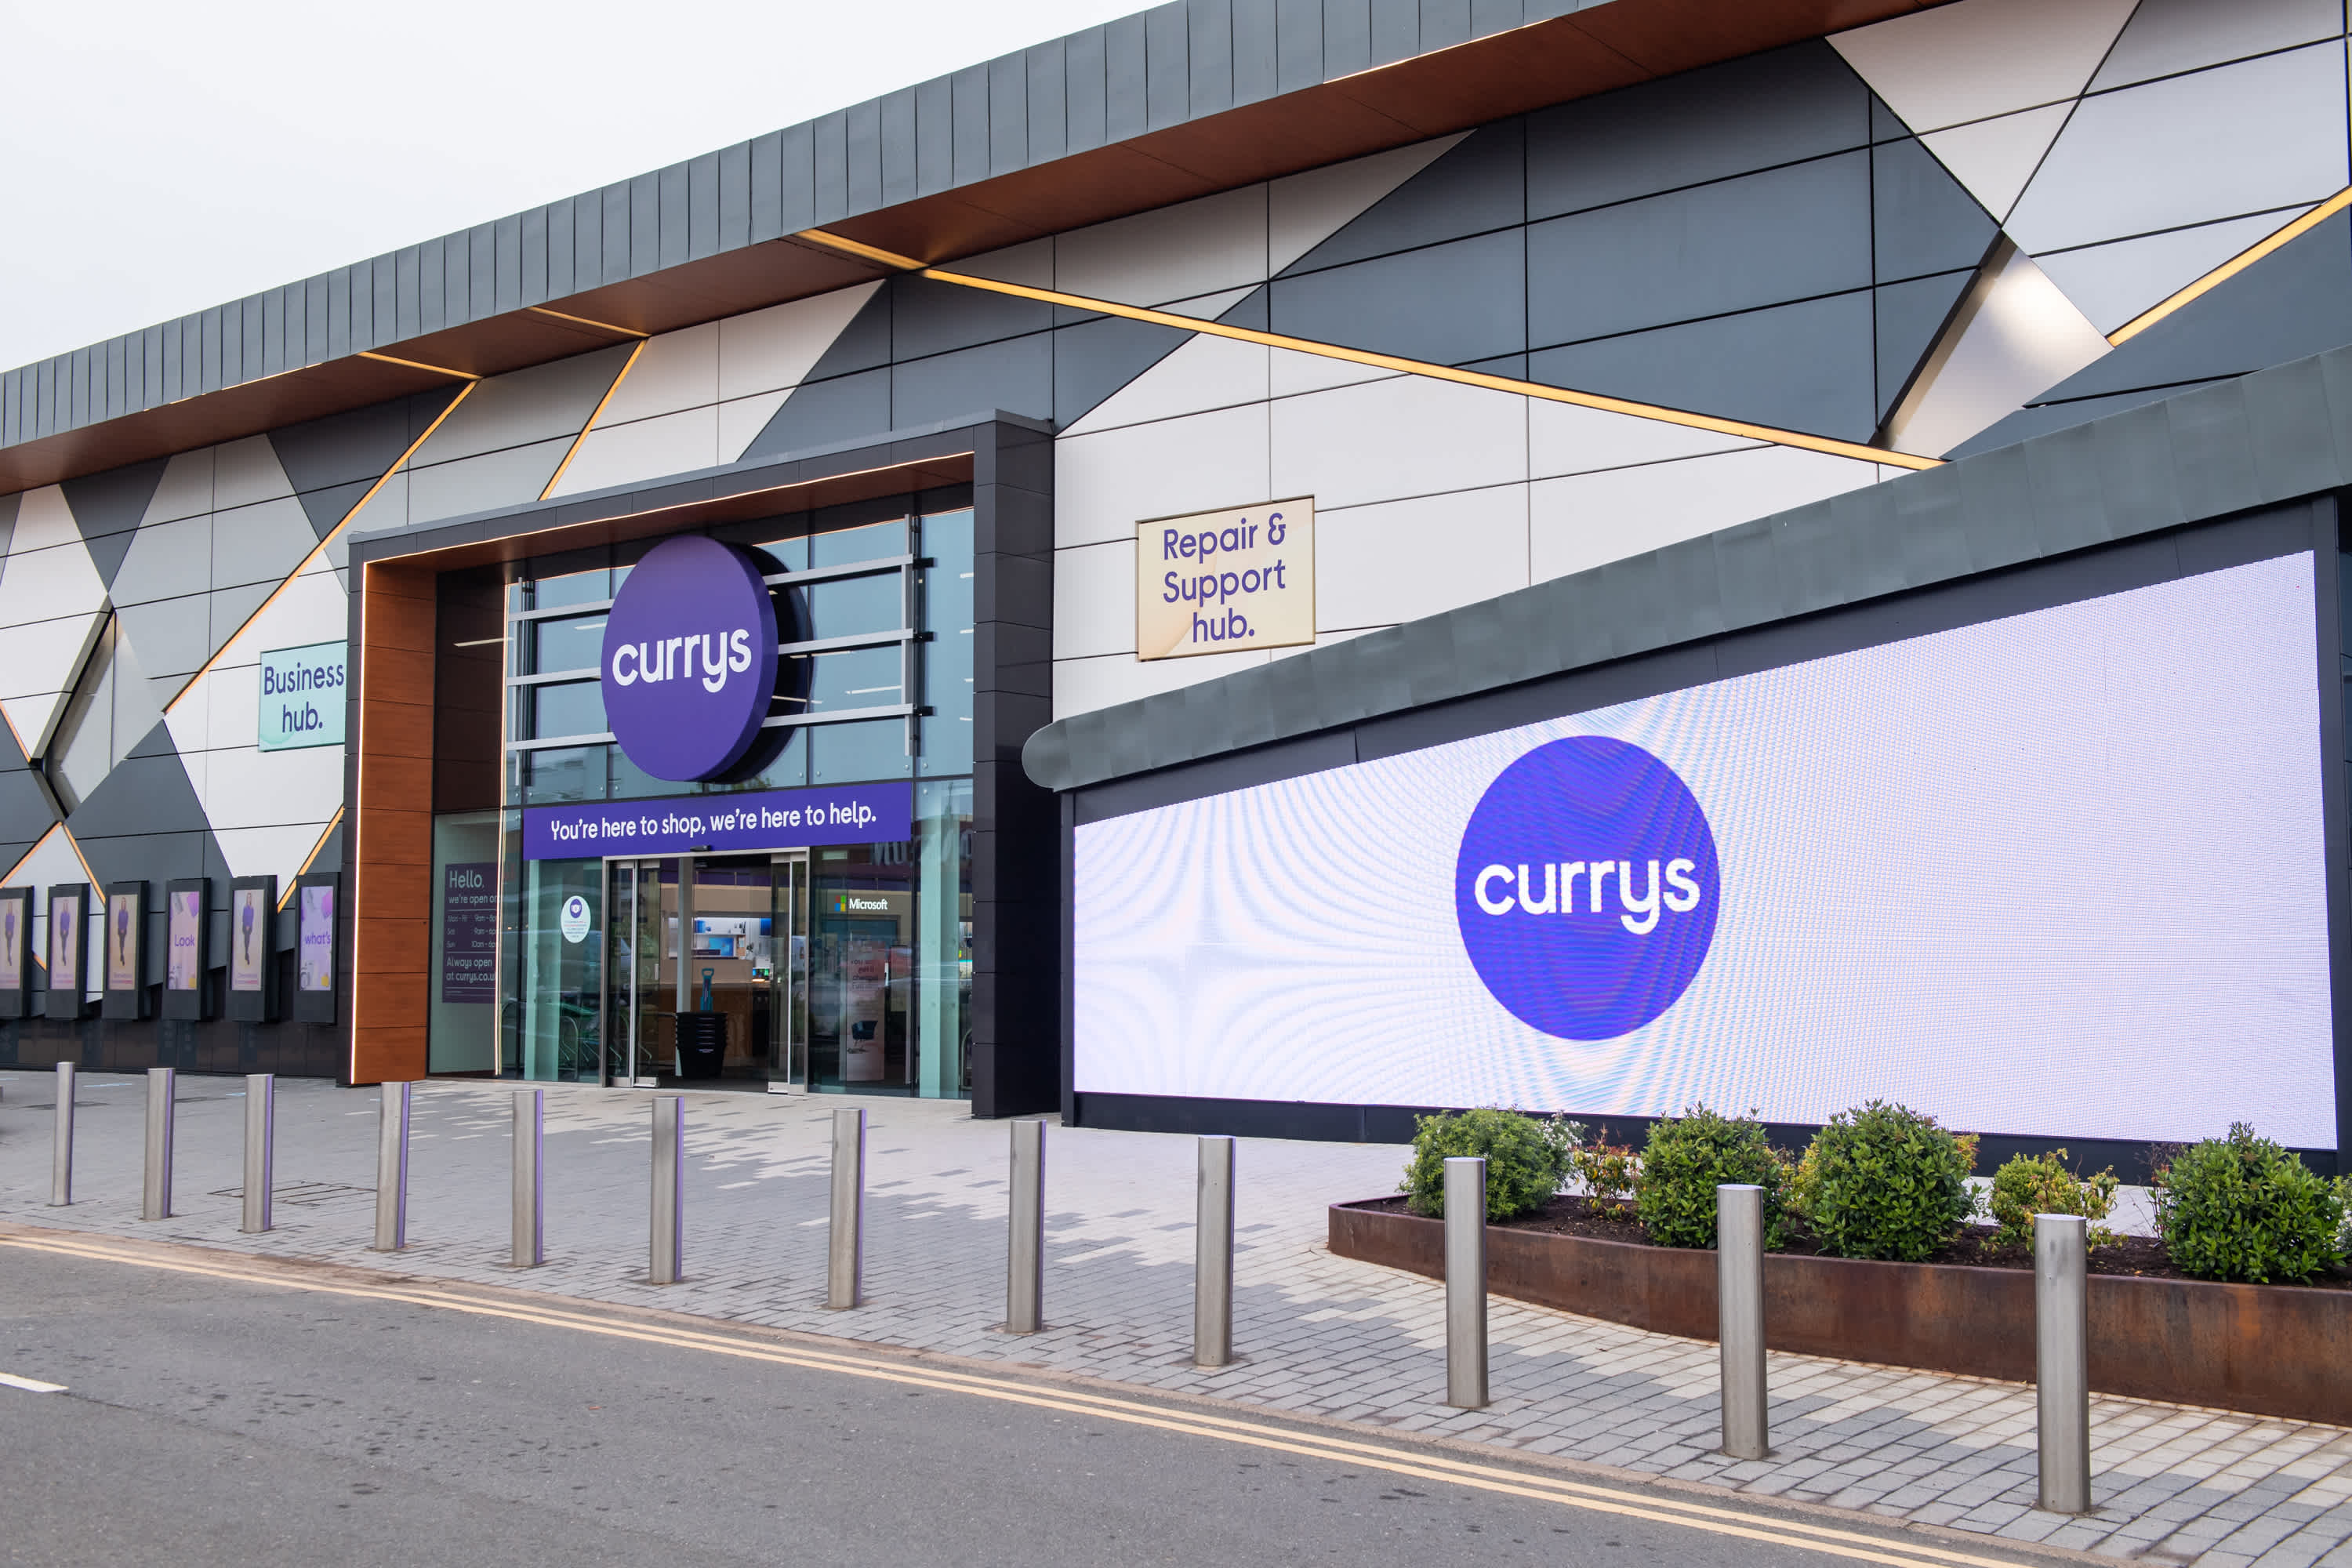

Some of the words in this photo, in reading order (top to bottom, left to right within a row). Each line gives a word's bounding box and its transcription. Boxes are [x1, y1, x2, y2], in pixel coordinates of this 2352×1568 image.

[1163, 517, 1258, 564] Repair
[1268, 513, 1286, 545] &
[1163, 559, 1286, 608] Support
[1192, 608, 1254, 643] hub.
[612, 629, 752, 693] currys
[264, 662, 344, 695] Business
[282, 701, 323, 733] hub.
[551, 818, 597, 840] You're
[601, 817, 636, 837] here
[640, 816, 658, 836] to
[662, 812, 706, 838] shop,
[710, 808, 757, 831] we're
[761, 807, 800, 829] here
[804, 805, 825, 826] to
[829, 800, 877, 829] help.
[470, 895, 488, 907] open
[849, 898, 888, 910] Microsoft
[1475, 858, 1700, 935] currys
[174, 934, 195, 947] Look
[305, 931, 331, 945] what's
[446, 971, 454, 981] at
[456, 972, 496, 984] currys.co.u
[447, 956, 472, 970] Always
[473, 959, 492, 971] open
